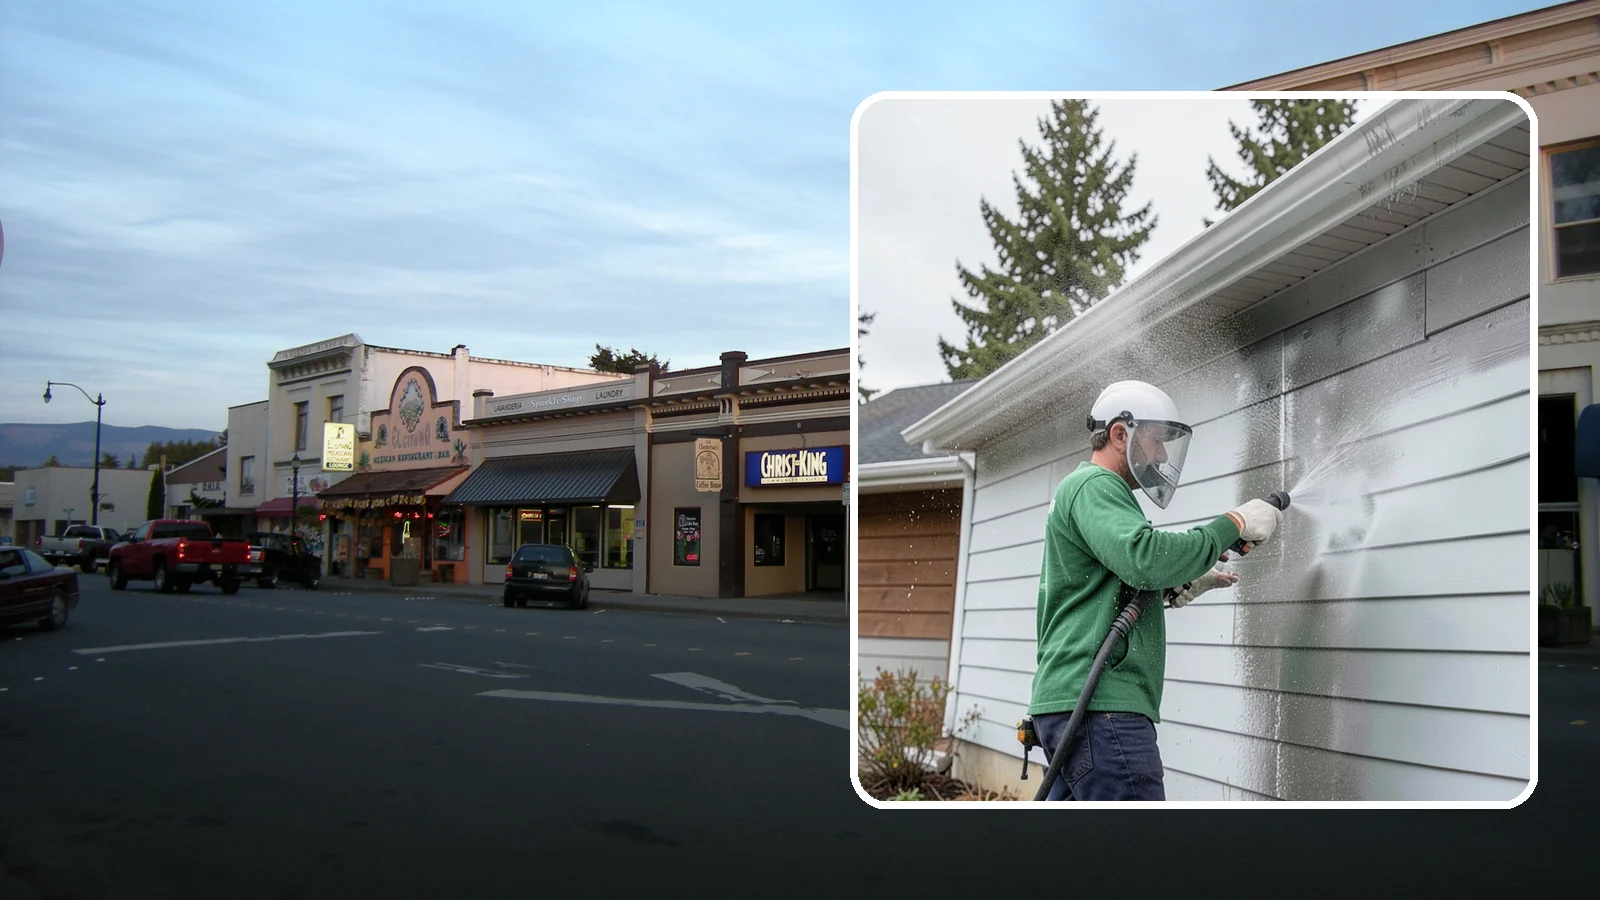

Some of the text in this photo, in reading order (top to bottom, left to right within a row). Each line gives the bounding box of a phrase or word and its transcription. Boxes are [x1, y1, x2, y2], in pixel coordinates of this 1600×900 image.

[493, 389, 624, 413] LAVANDERIA Sparkle Shop LAUNDRY
[374, 450, 450, 465] MEXICAN RESTAURANT BAR
[761, 450, 827, 478] CHRIST KING
[696, 480, 709, 489] Coffee
